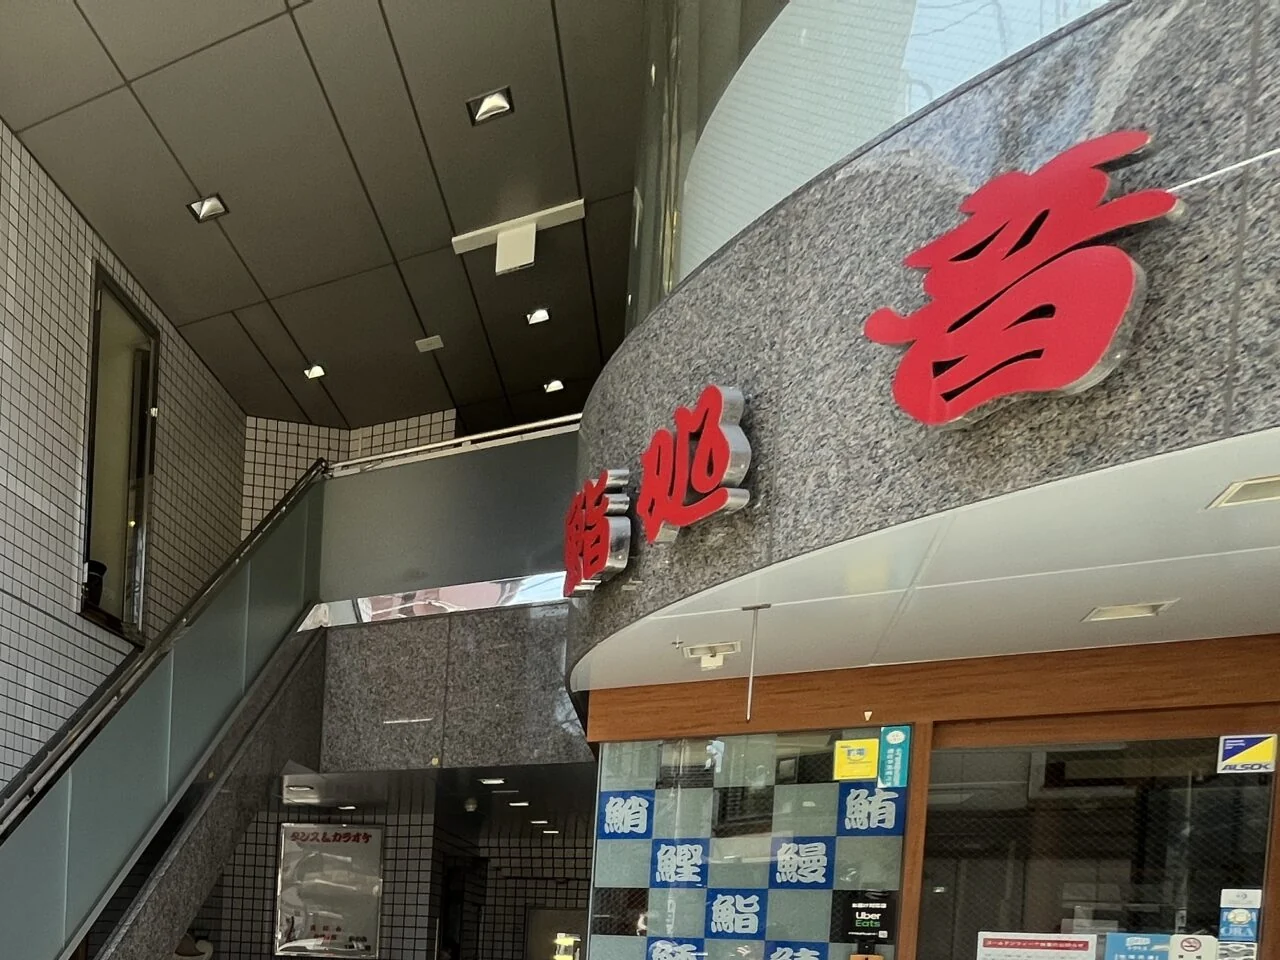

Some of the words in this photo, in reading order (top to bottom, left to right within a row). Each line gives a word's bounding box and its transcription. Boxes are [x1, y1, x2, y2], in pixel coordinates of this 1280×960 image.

[776, 842, 827, 883] 鰻
[711, 894, 759, 934] 鮨
[855, 911, 881, 920] Uber
[855, 919, 880, 928] Eats
